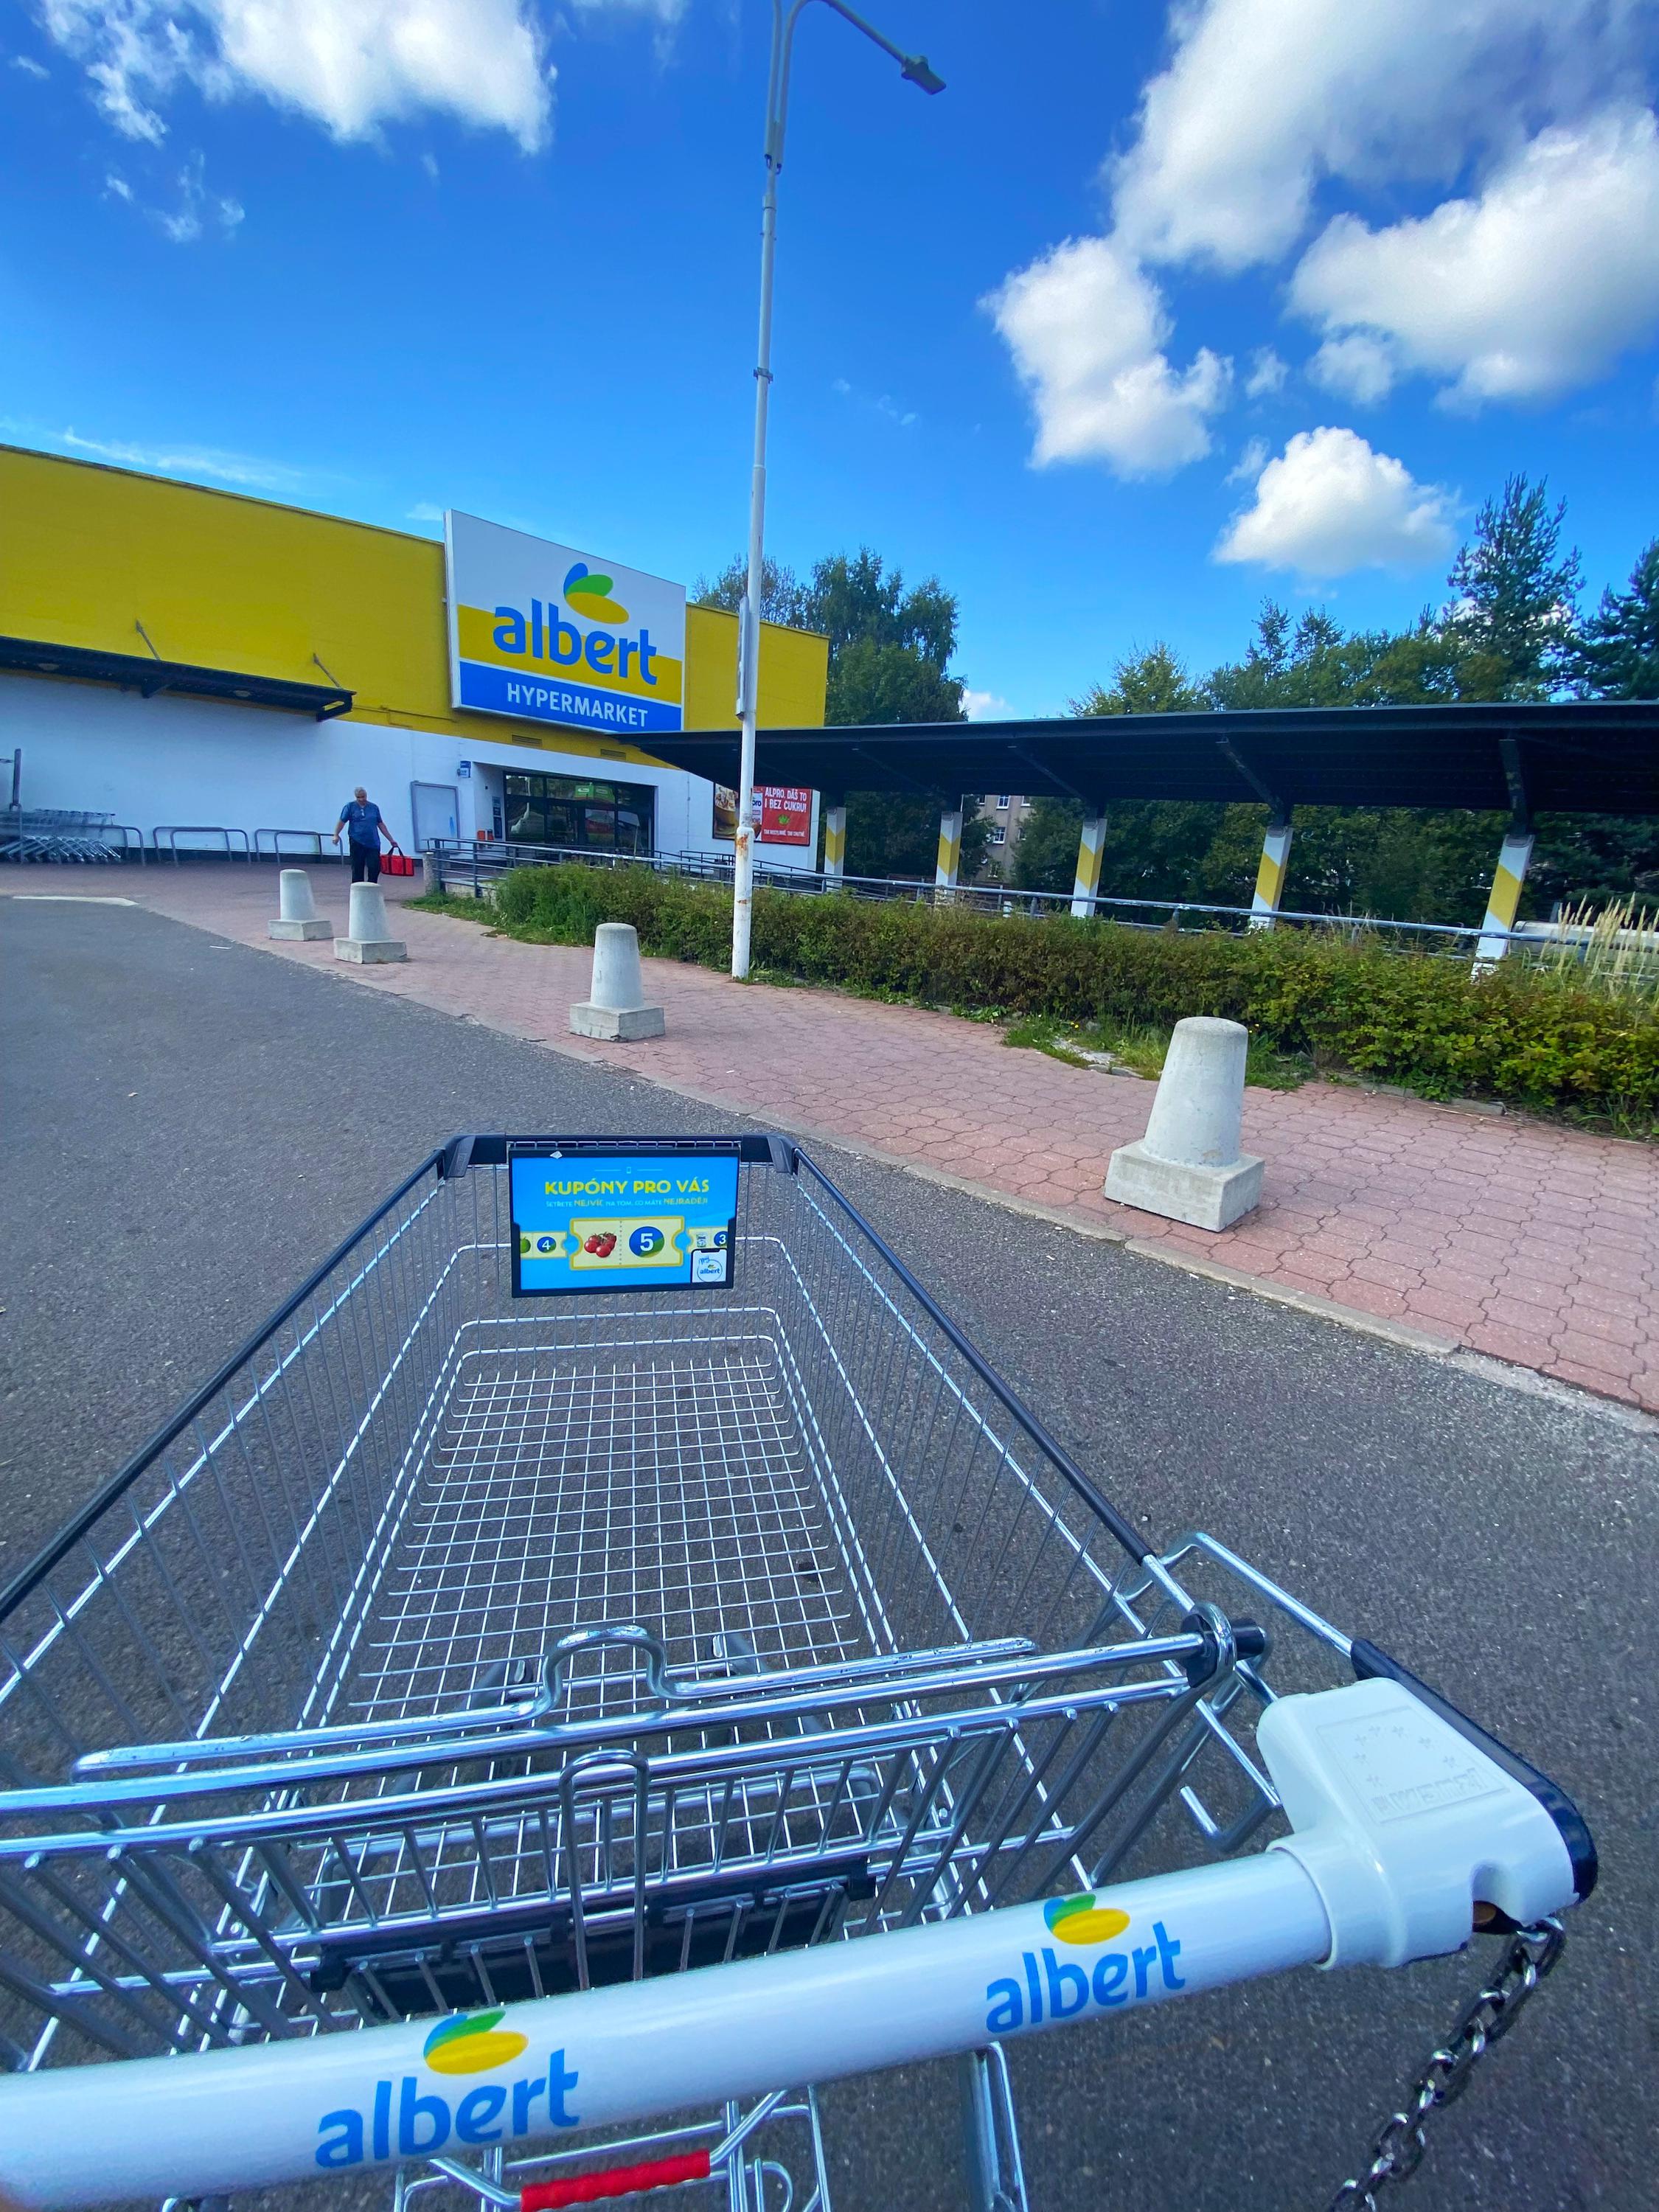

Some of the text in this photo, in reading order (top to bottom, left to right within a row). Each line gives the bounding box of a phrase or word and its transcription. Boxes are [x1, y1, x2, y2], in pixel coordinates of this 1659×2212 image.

[493, 598, 658, 686] albert
[507, 682, 649, 728] HYPERMARKET
[769, 799, 782, 810] BEZ
[799, 792, 807, 801] TO
[544, 1176, 710, 1195] KUPÓNY PRO VÁS
[541, 1239, 552, 1251] 4
[639, 1233, 655, 1252] 5
[719, 1234, 726, 1245] 3
[985, 1921, 1186, 2035] albert
[315, 2049, 580, 2169] albert
